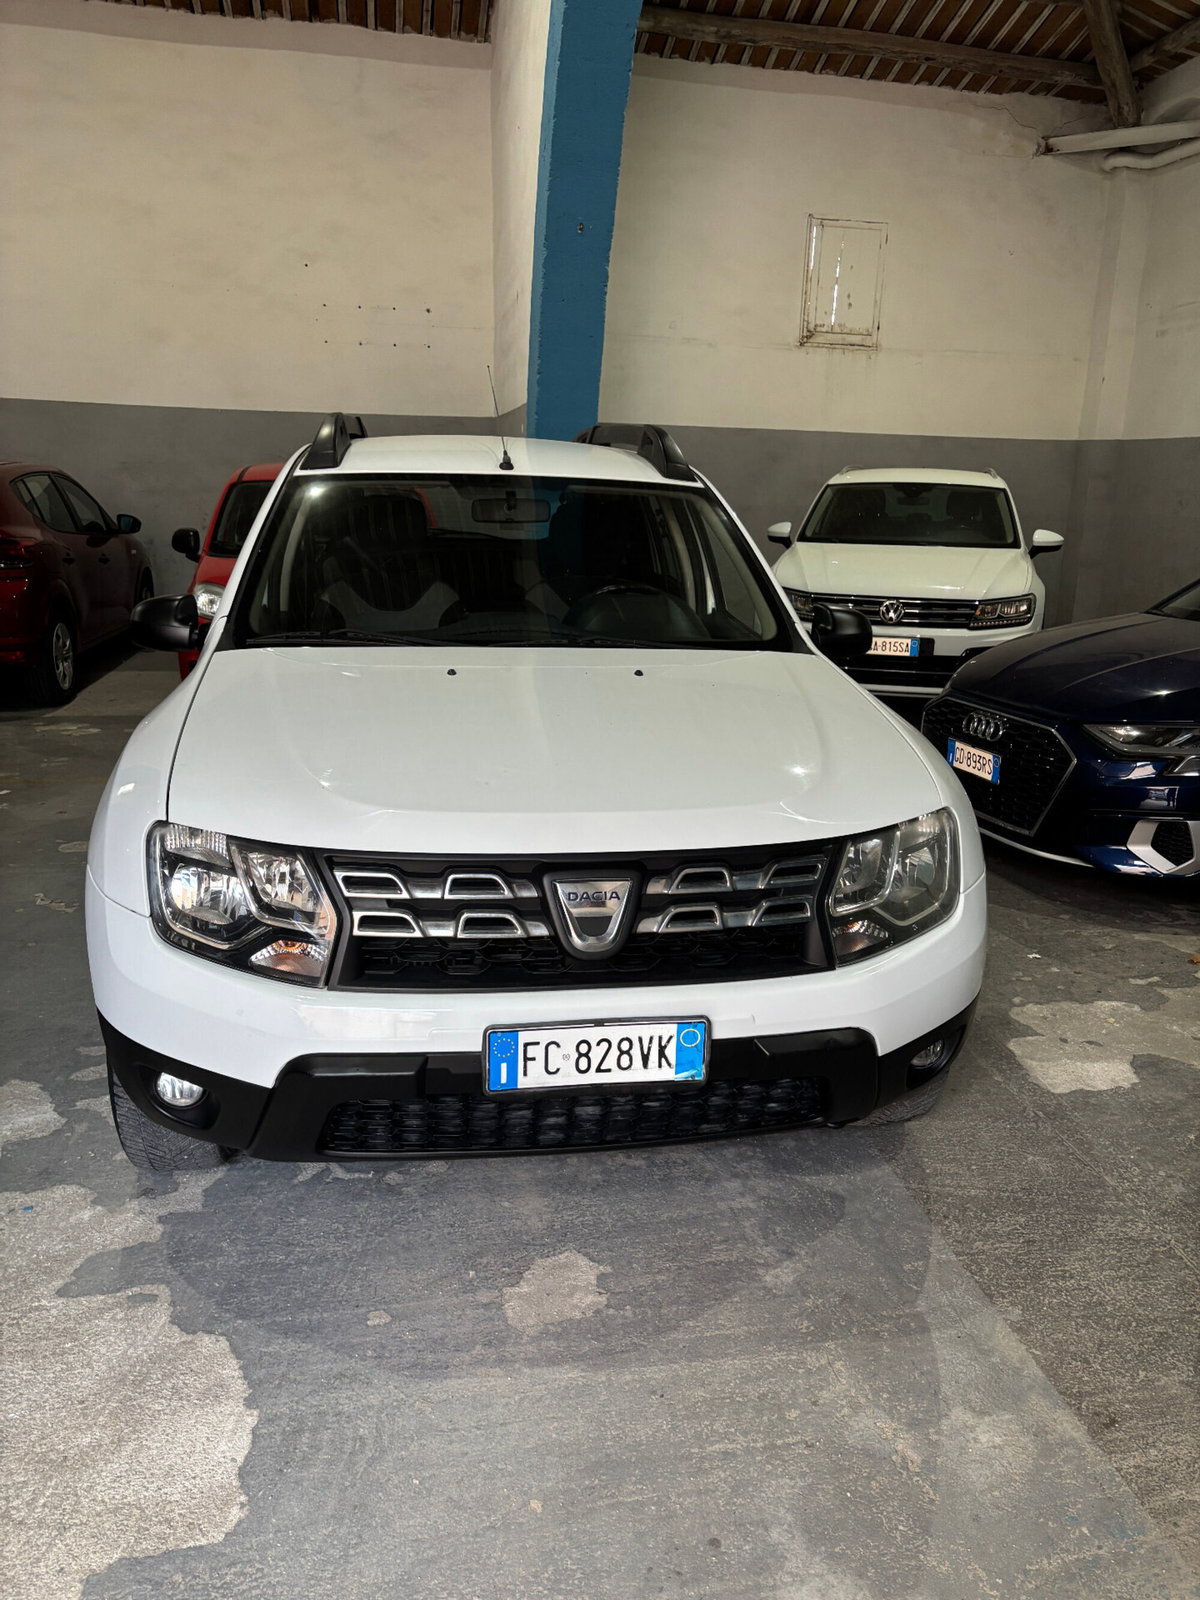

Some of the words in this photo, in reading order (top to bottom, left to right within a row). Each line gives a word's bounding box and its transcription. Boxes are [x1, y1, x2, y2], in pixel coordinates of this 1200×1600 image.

[567, 891, 620, 901] DACIA
[522, 1040, 561, 1077] FC
[574, 1034, 674, 1074] 828VK
